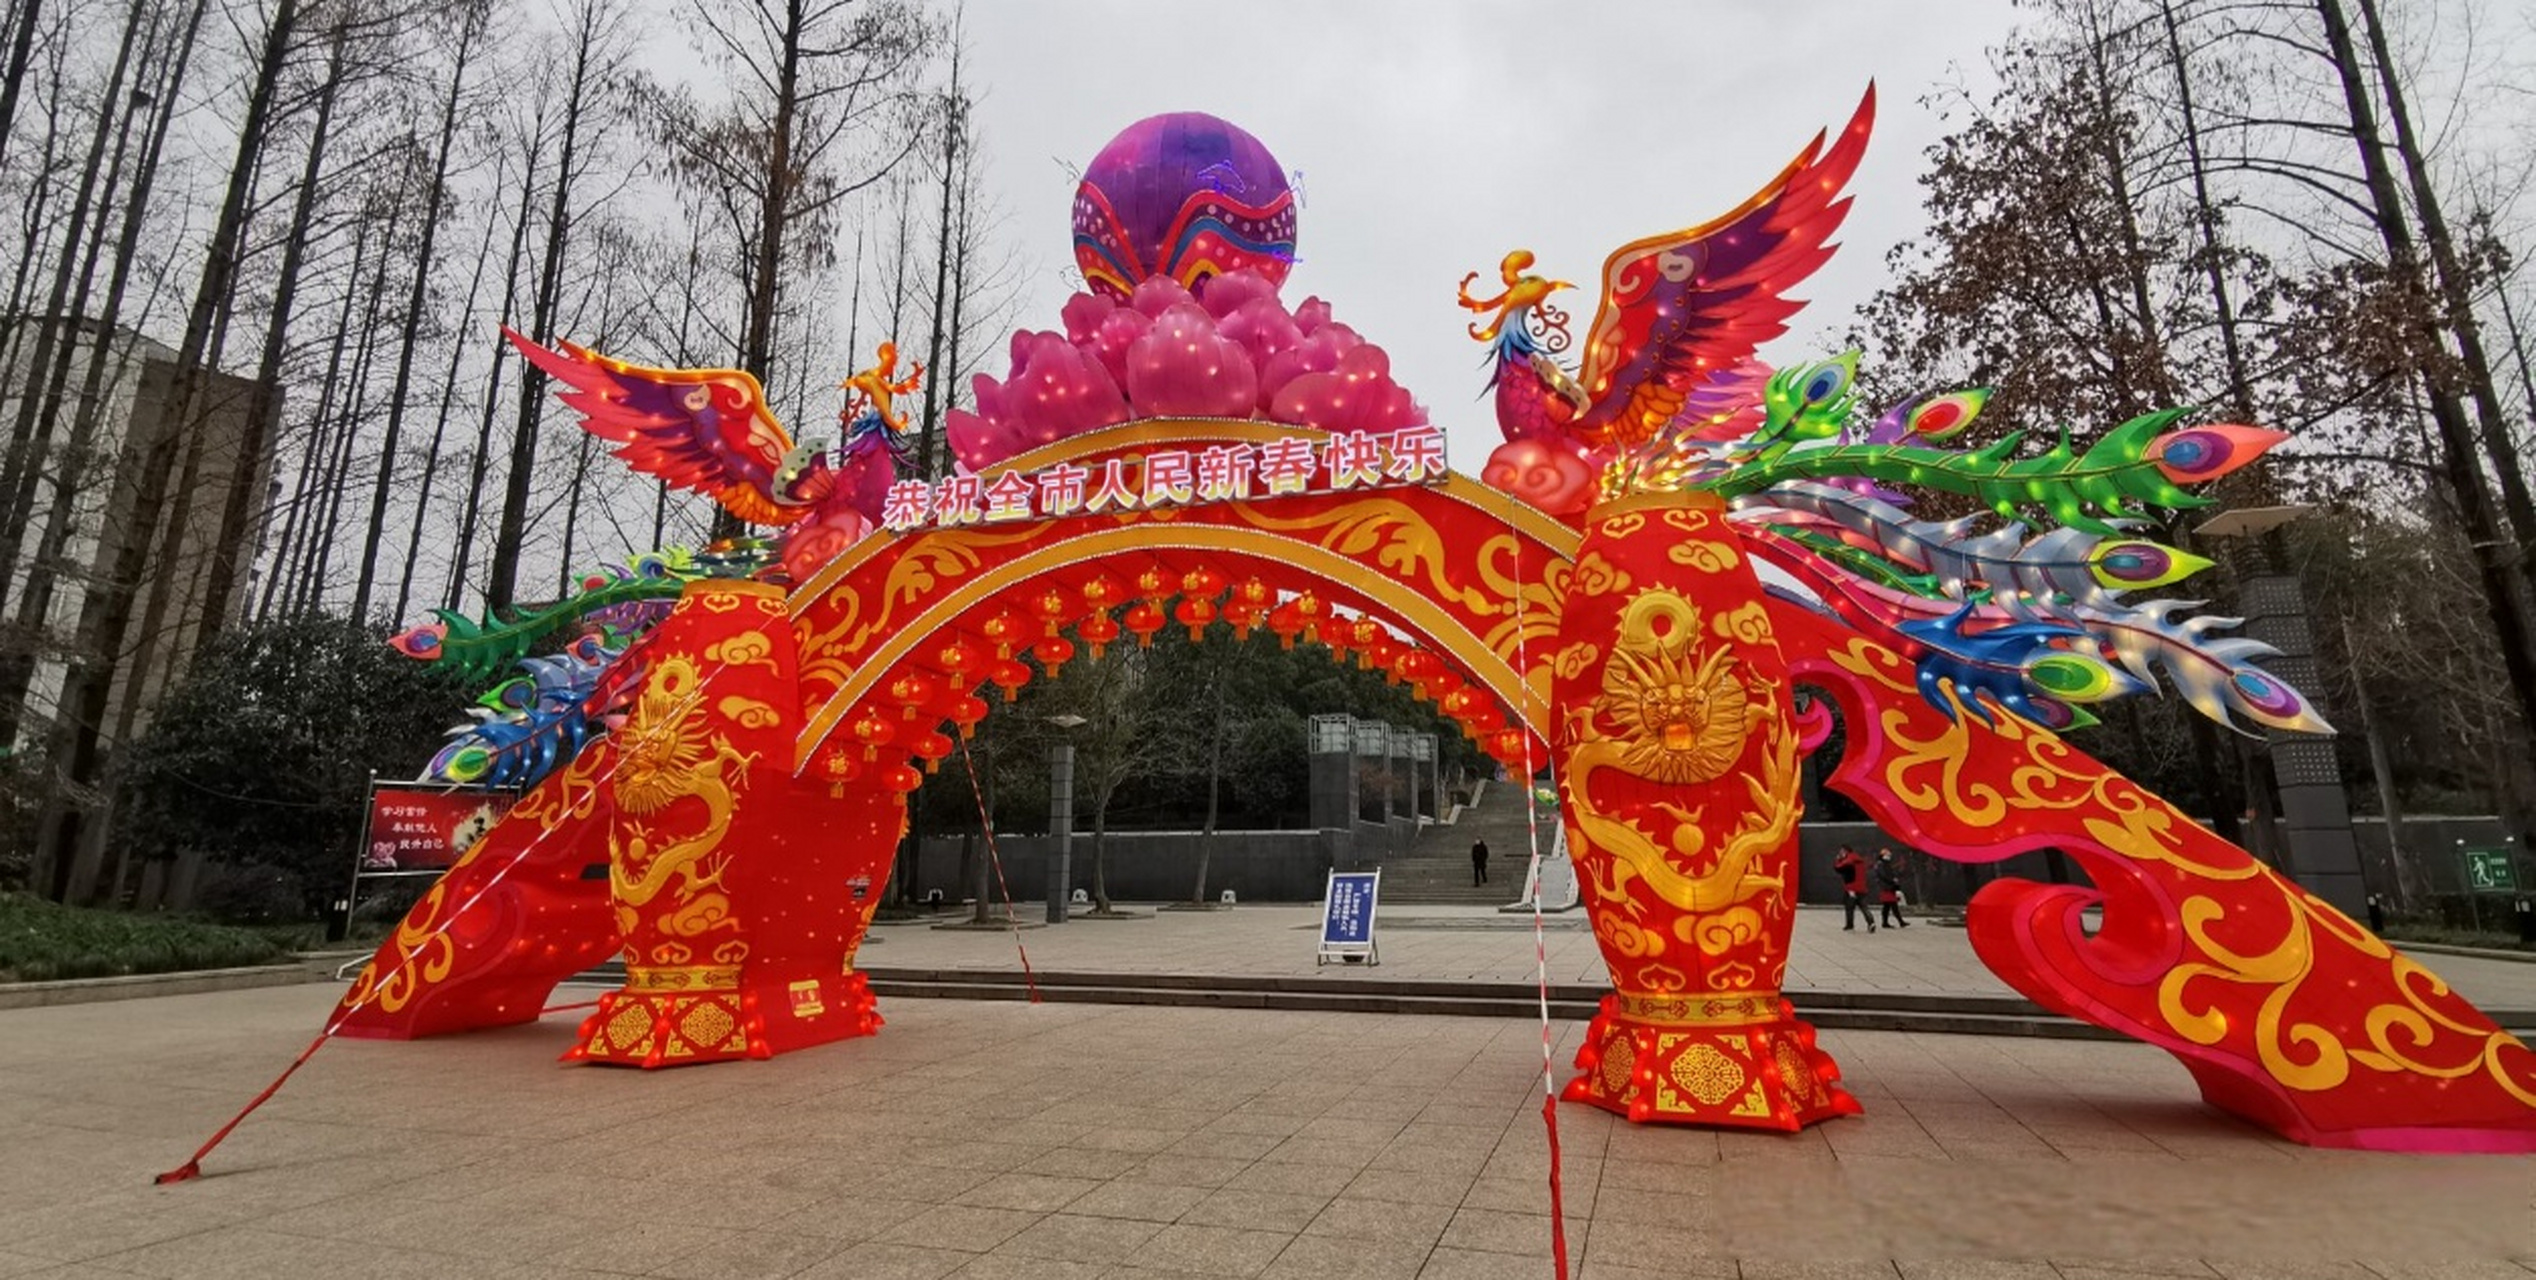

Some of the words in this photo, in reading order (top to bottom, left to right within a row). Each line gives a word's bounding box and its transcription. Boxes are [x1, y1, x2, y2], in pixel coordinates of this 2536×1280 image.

[882, 425, 1446, 531] 恭祝全市人民新春快乐
